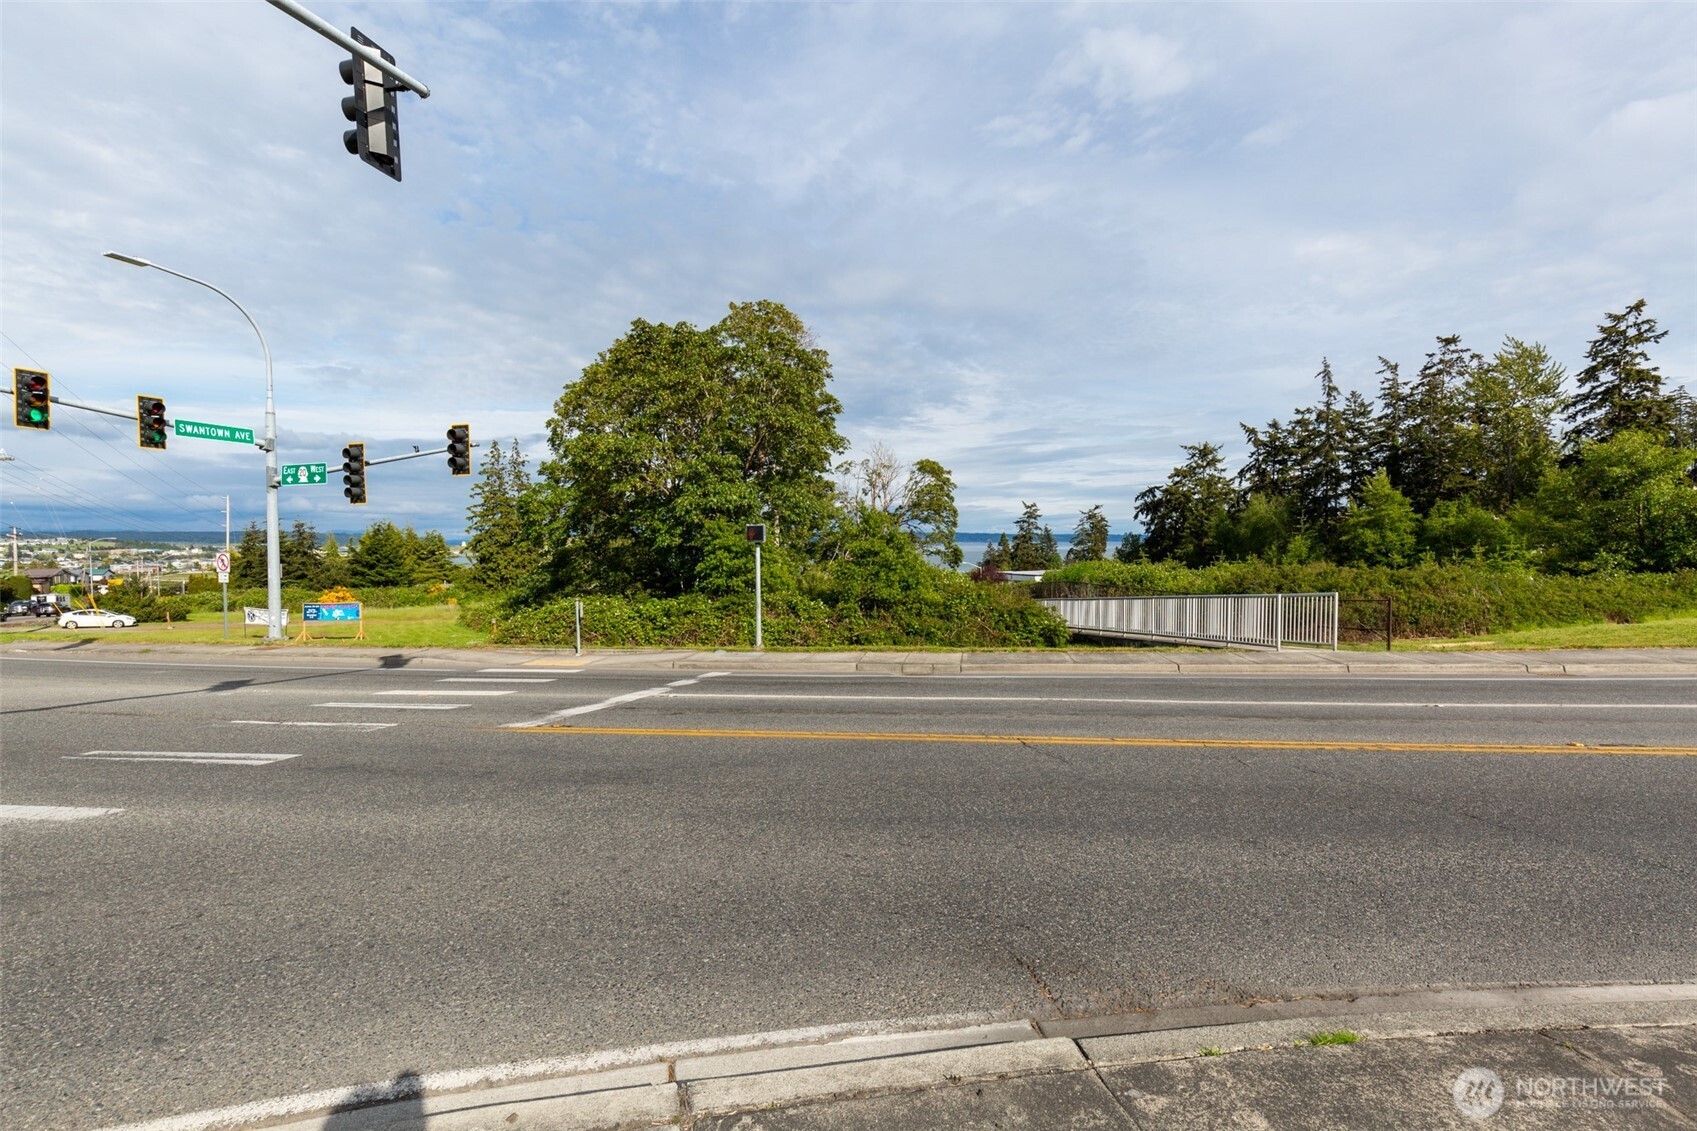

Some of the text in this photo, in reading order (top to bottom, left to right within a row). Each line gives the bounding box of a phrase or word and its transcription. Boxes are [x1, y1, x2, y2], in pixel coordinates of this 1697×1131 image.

[179, 423, 251, 441] SWANTOWN AVE
[283, 466, 296, 475] EAST
[310, 465, 325, 473] WEST
